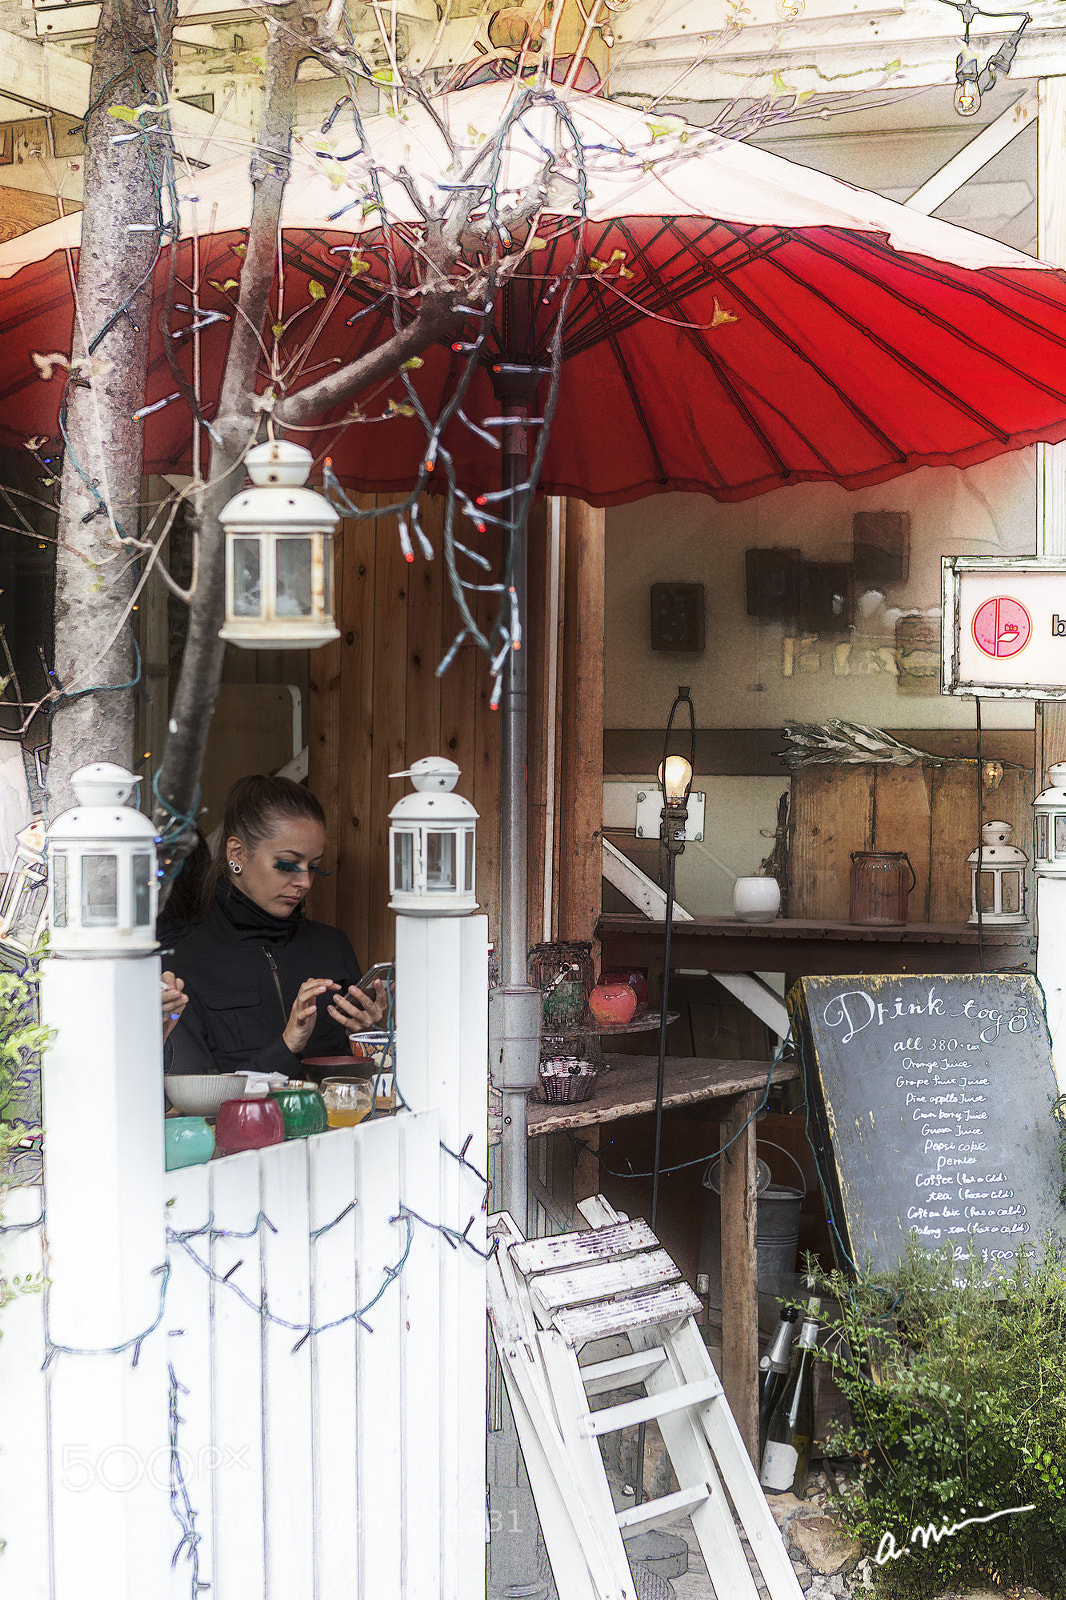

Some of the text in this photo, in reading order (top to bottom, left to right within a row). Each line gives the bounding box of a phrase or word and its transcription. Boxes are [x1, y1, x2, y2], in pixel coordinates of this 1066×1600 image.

[823, 987, 946, 1044] Drink
[893, 1037, 924, 1052] all
[902, 1057, 972, 1073] Orange Juice
[896, 1074, 990, 1088] Grape fruit Juice
[905, 1092, 927, 1106] Pine
[958, 1093, 987, 1104] Juice
[912, 1108, 937, 1121] Cran
[963, 1109, 988, 1122] Juice
[921, 1123, 983, 1137] Guava Juice
[924, 1138, 956, 1154] Pepsi
[915, 1173, 954, 1187] Coffee
[925, 1190, 953, 1202] tea
